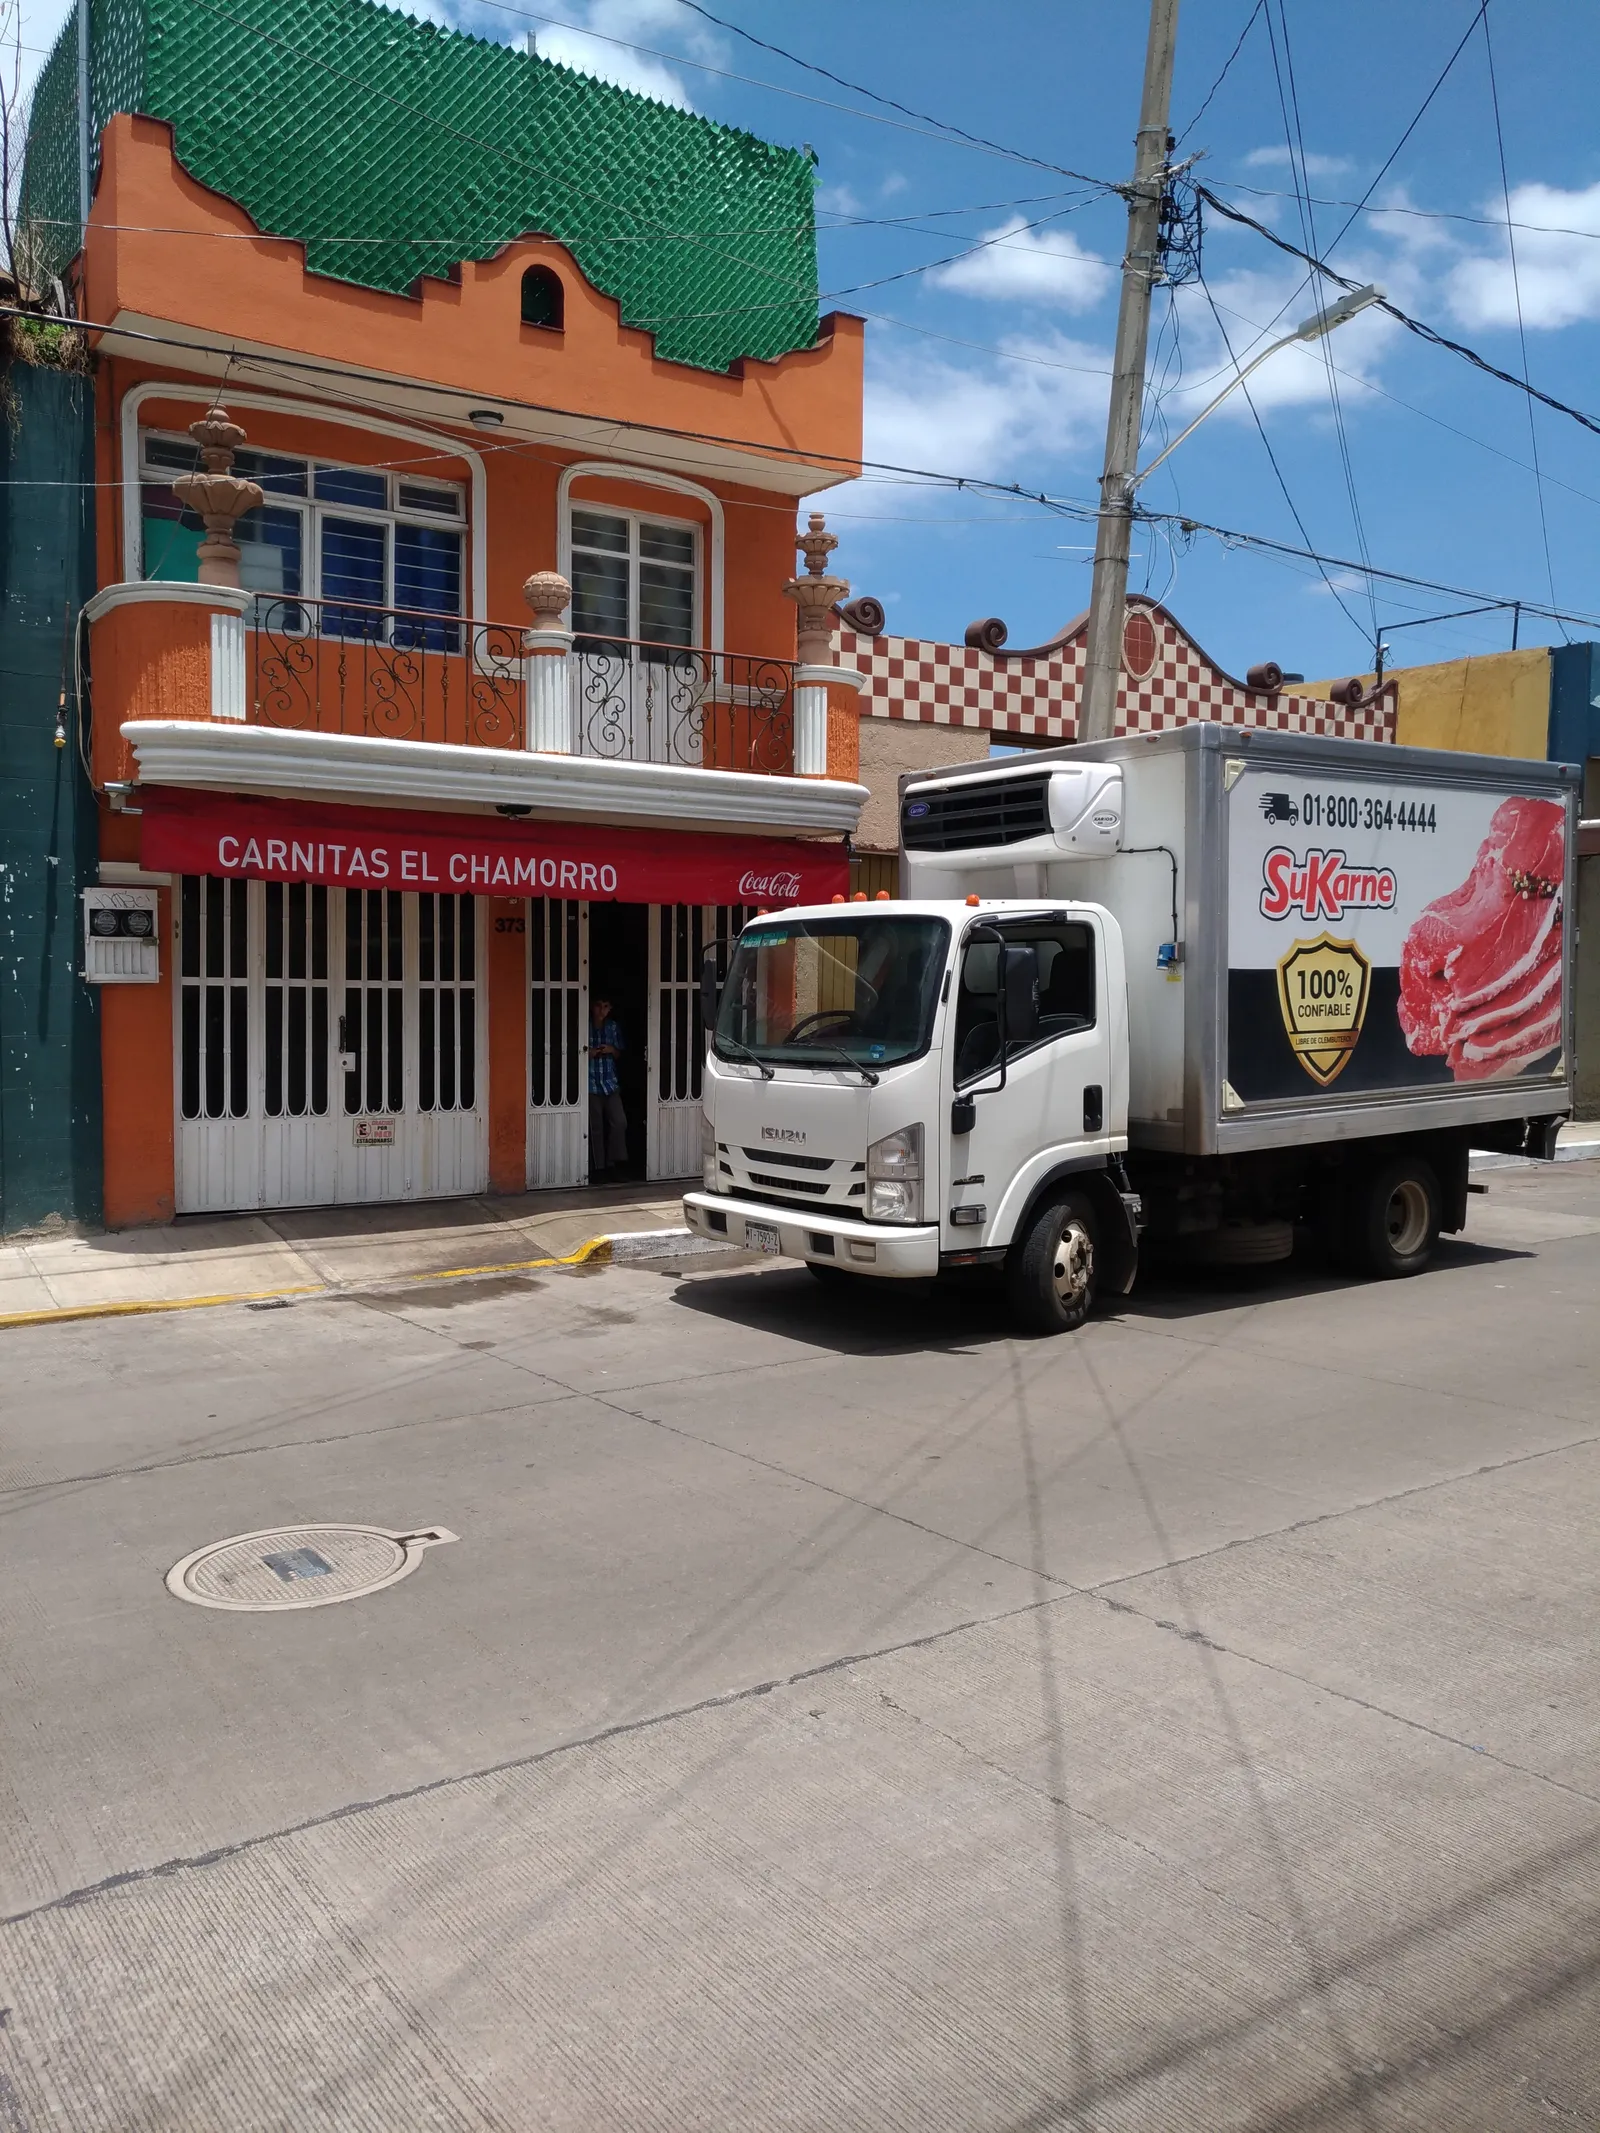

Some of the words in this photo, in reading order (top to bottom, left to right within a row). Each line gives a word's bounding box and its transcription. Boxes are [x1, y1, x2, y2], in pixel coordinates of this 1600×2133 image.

[218, 835, 390, 878] CARNITAS
[401, 850, 439, 882] EL
[449, 853, 618, 892] CHAMORRO
[738, 870, 803, 898] Coca-Cola
[1263, 852, 1394, 915] SuKarne
[494, 917, 526, 934] 373
[1297, 969, 1354, 1000] 100%
[1297, 1003, 1352, 1018] CONFIABLE
[761, 1126, 807, 1144] ISUZU
